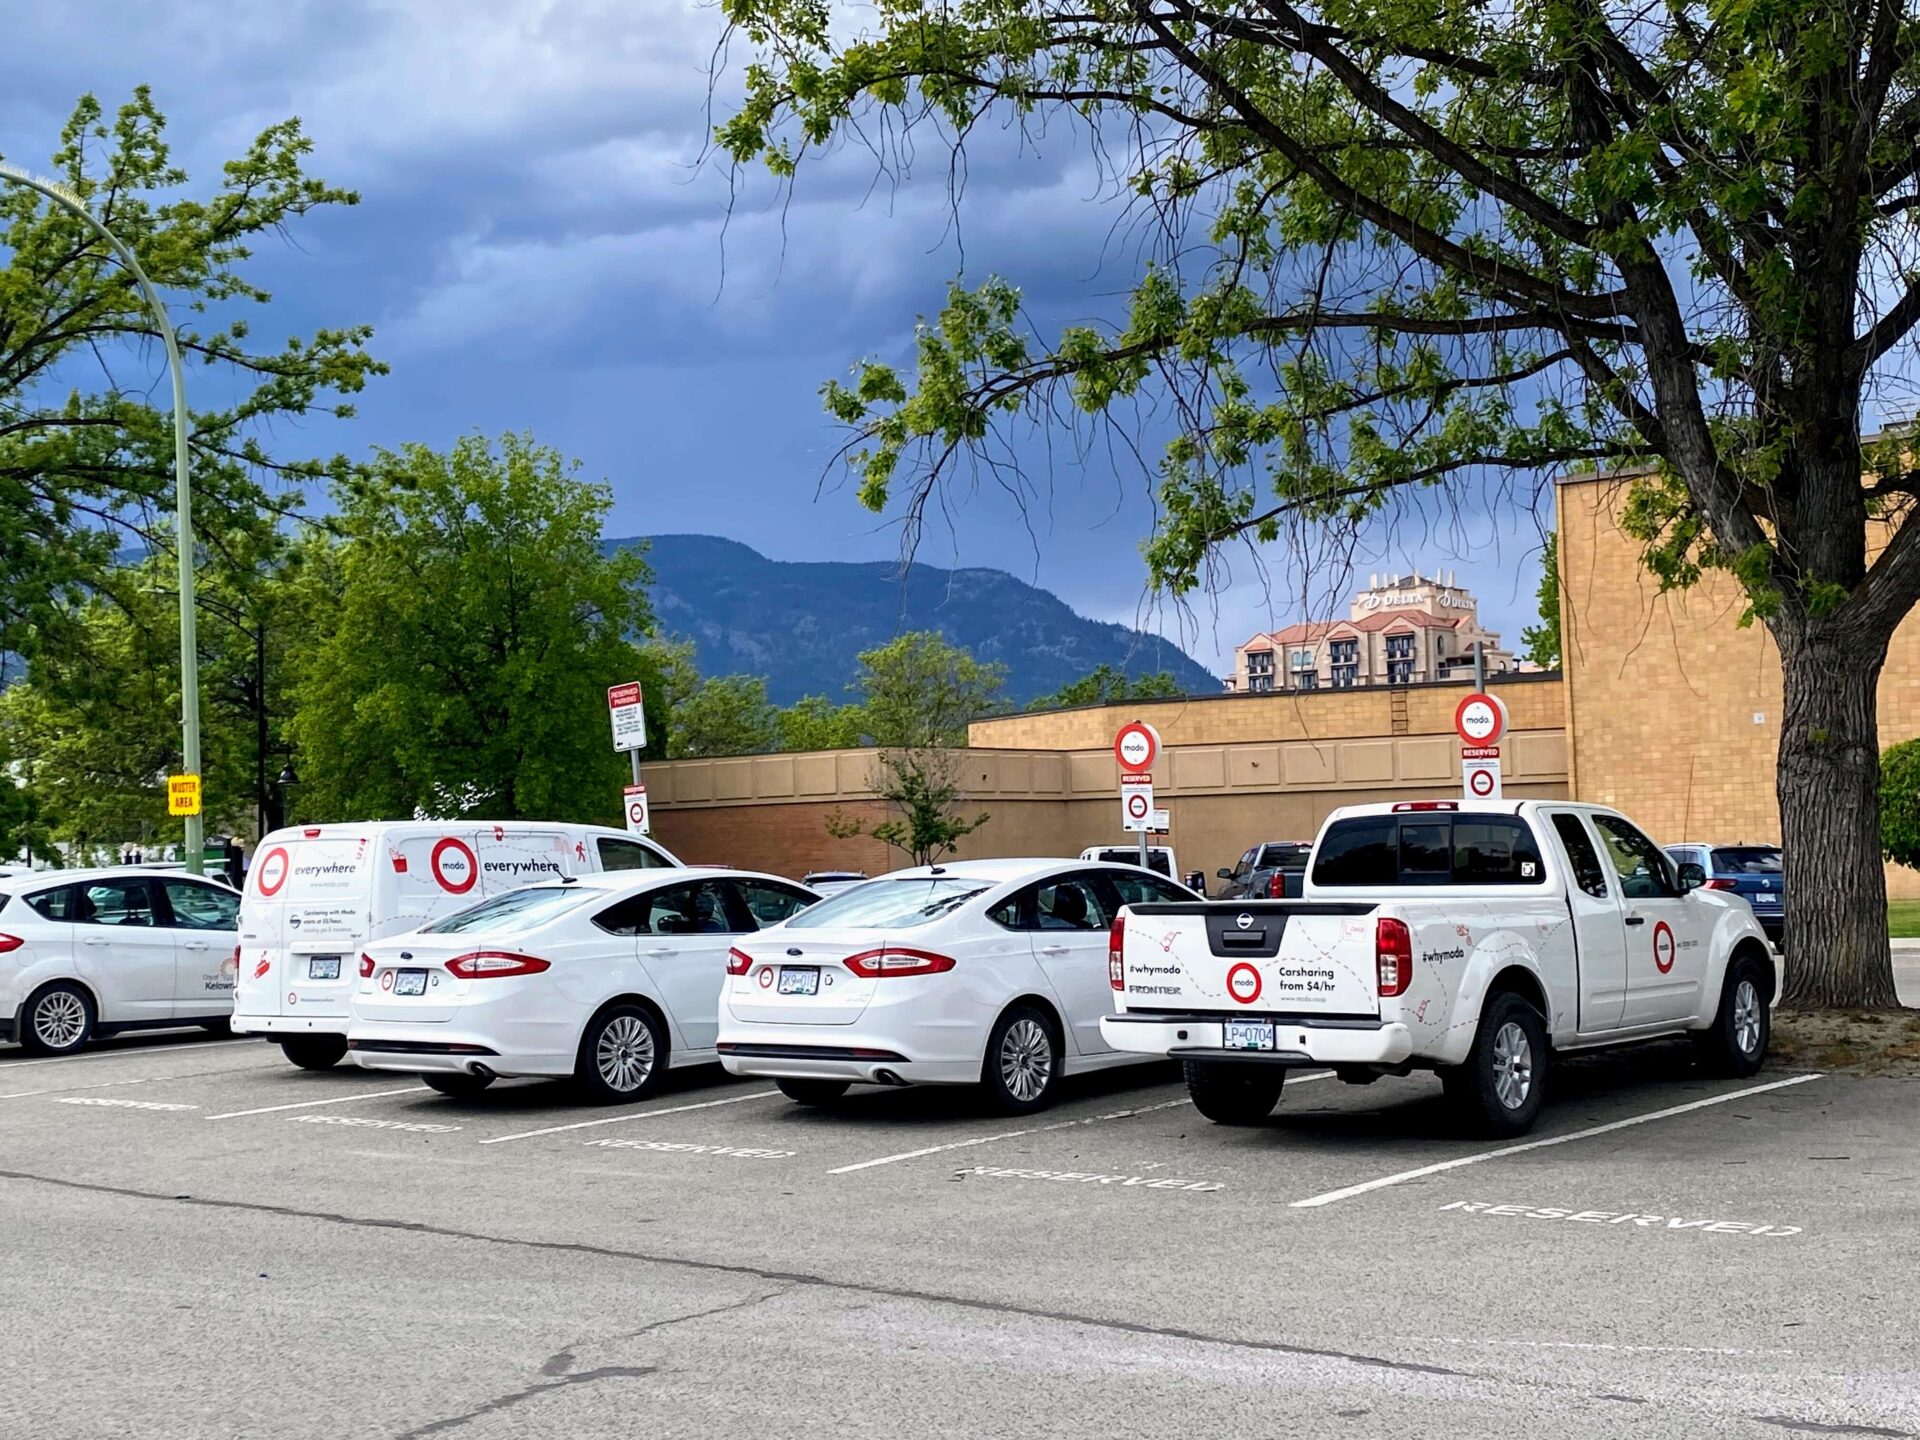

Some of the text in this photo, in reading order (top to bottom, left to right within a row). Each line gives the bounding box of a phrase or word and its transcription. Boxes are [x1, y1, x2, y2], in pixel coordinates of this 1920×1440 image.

[1383, 593, 1424, 606] DELTA
[1466, 715, 1489, 724] modo
[1124, 743, 1144, 752] modo
[1463, 748, 1498, 757] RESERVED
[171, 781, 196, 793] MUSTER
[175, 796, 193, 808] AREA
[294, 861, 356, 877] everywhere
[442, 861, 465, 870] modo
[484, 858, 560, 876] everywhere
[1422, 945, 1465, 964] #whymodo
[1129, 964, 1181, 977] #whymodo
[1279, 966, 1335, 980] Carsharing
[1234, 978, 1254, 987] modo
[1279, 980, 1336, 993] from $4/hr
[1129, 984, 1182, 996] FRONTIER
[285, 1115, 463, 1133] RESERVED
[583, 1138, 797, 1158] RESERVED
[954, 1166, 1225, 1191] RESERVED
[1438, 1200, 1803, 1236] RESERVED
